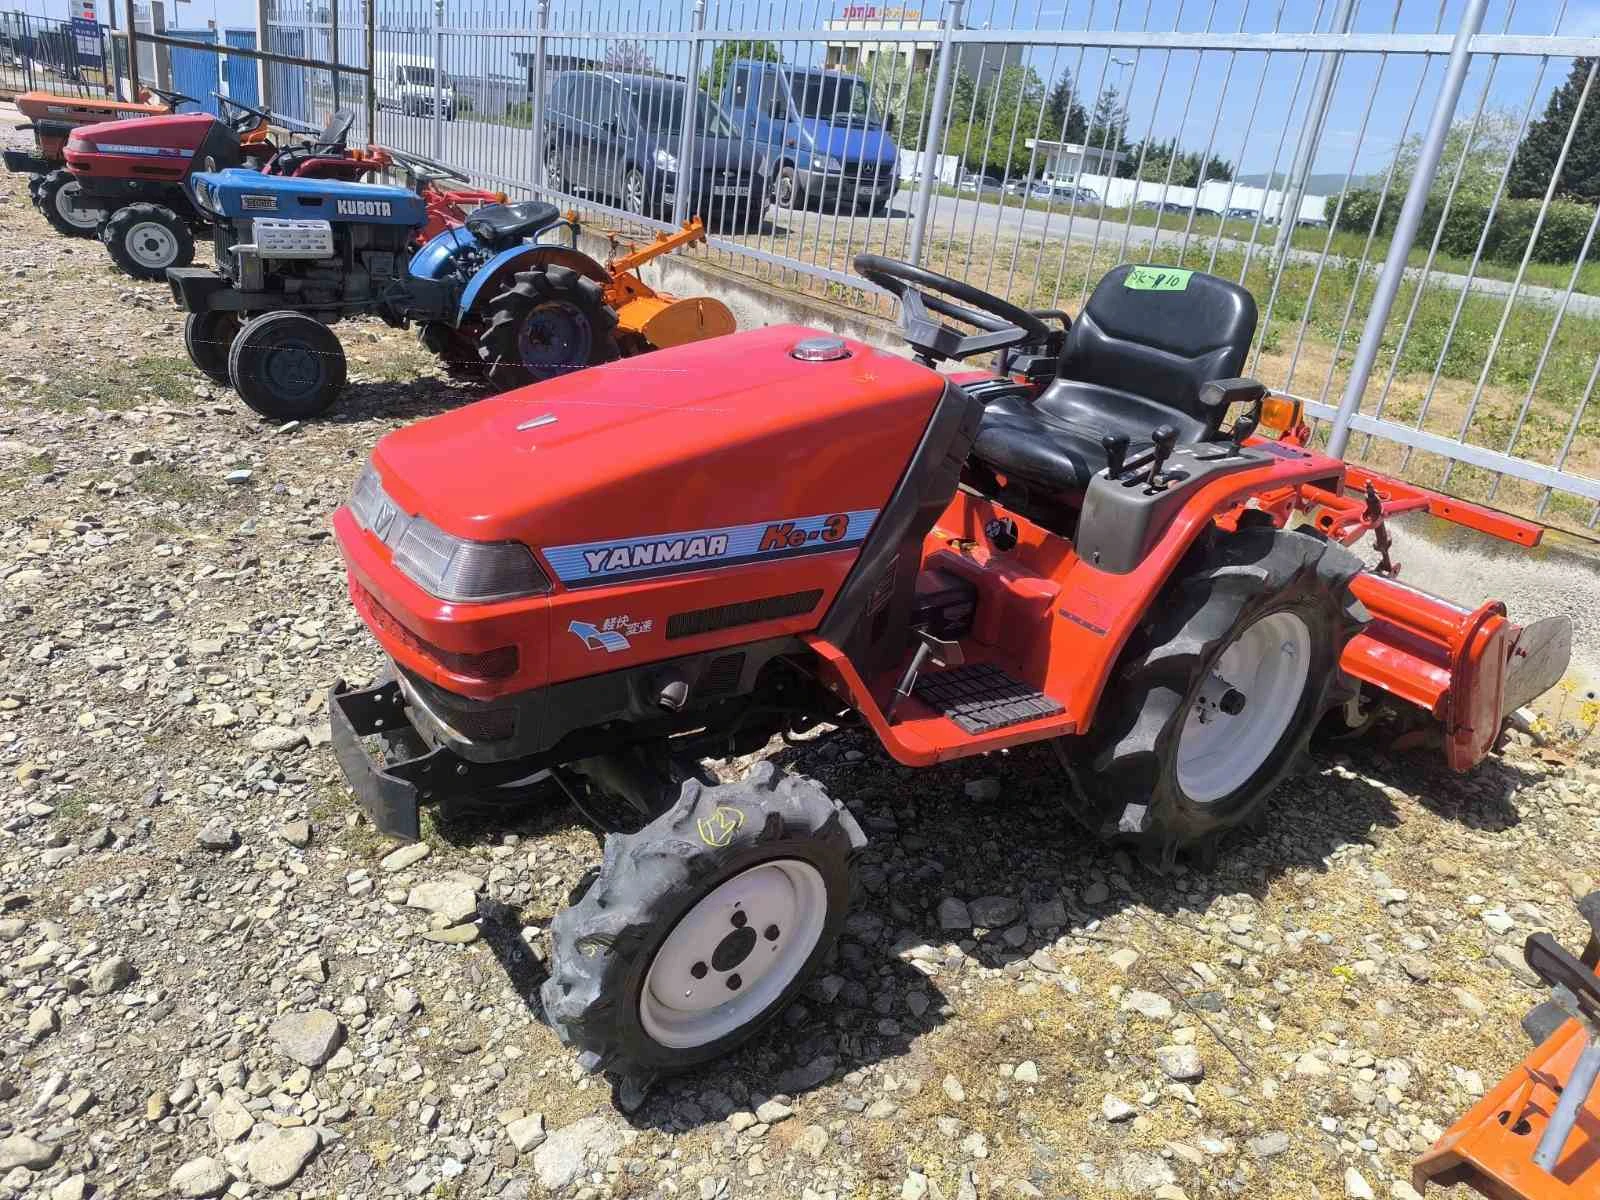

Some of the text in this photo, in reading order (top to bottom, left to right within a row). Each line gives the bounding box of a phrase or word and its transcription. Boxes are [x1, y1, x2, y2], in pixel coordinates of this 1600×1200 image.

[337, 199, 392, 217] KUBOTA
[757, 513, 850, 551] Ke-3
[583, 533, 729, 573] YANMAR
